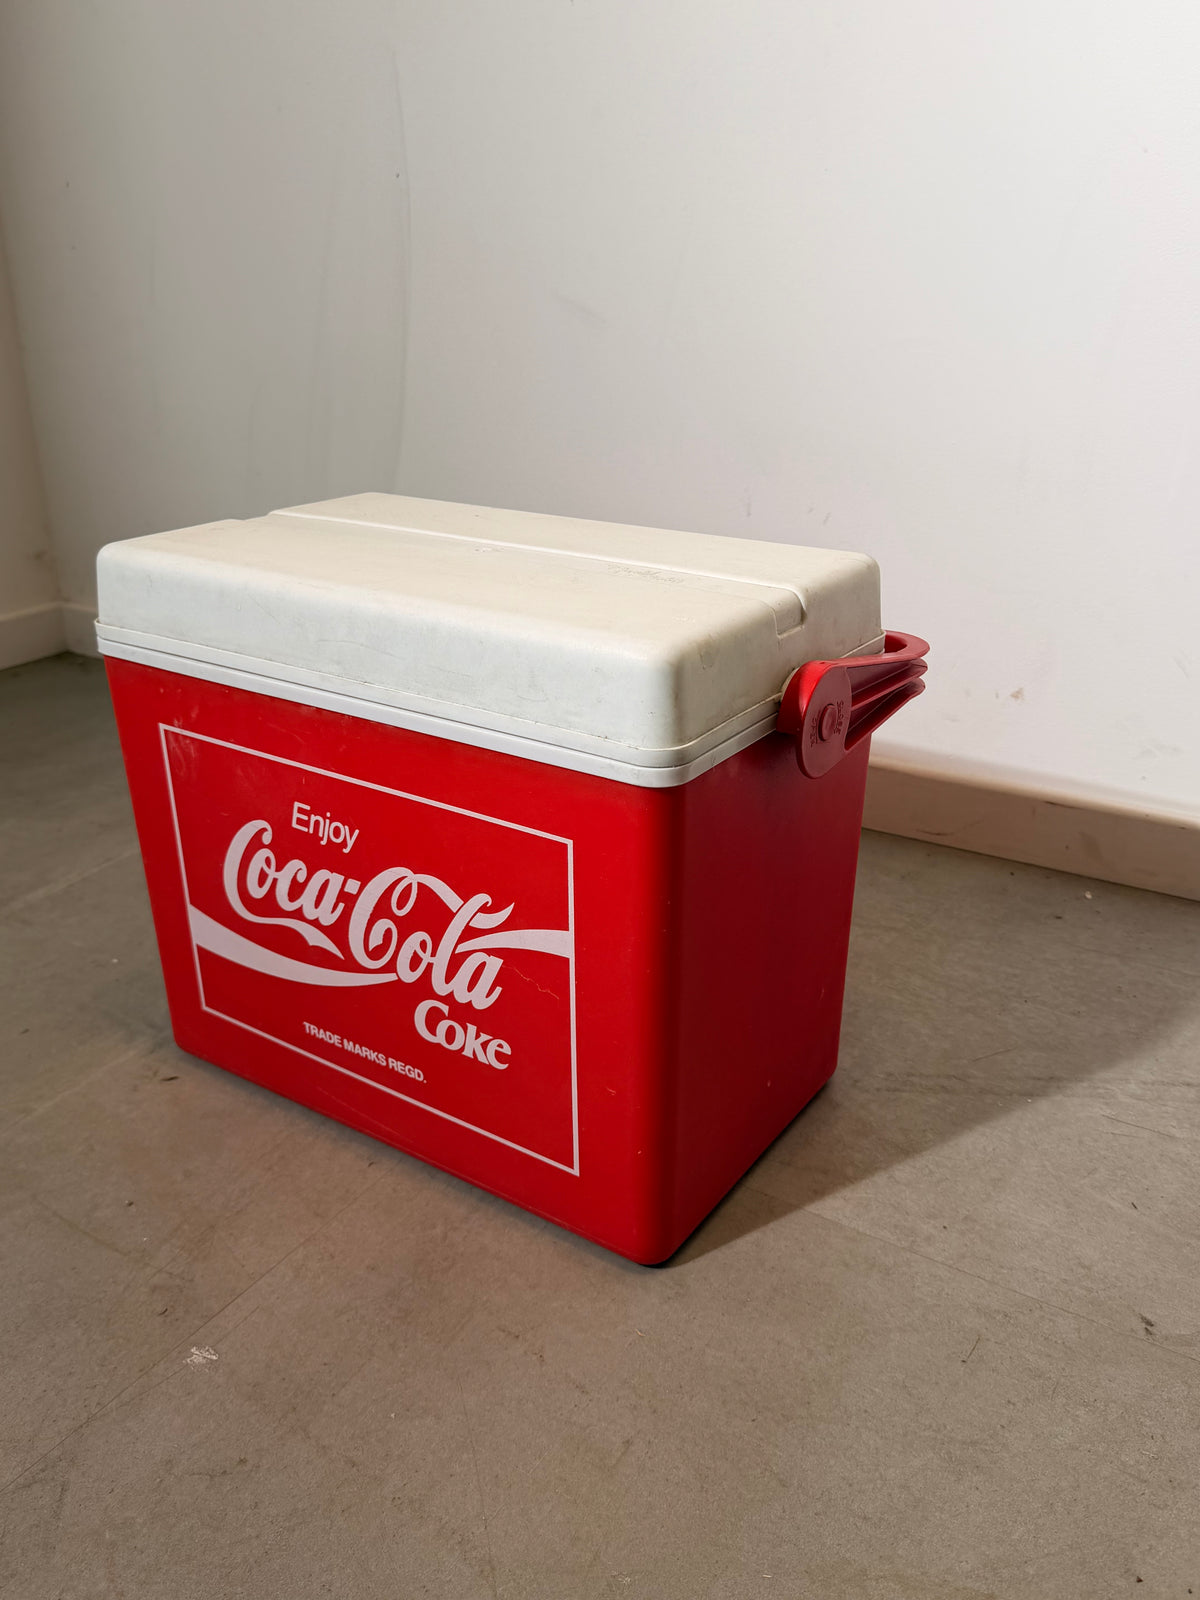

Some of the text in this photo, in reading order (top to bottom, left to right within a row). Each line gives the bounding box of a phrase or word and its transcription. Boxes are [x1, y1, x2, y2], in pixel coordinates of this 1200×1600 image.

[291, 801, 360, 853] Enjoy
[223, 819, 515, 1010] Coca-Cola
[303, 1022, 427, 1084] TRADE MARKS REGD.
[414, 1000, 512, 1070] Coke
